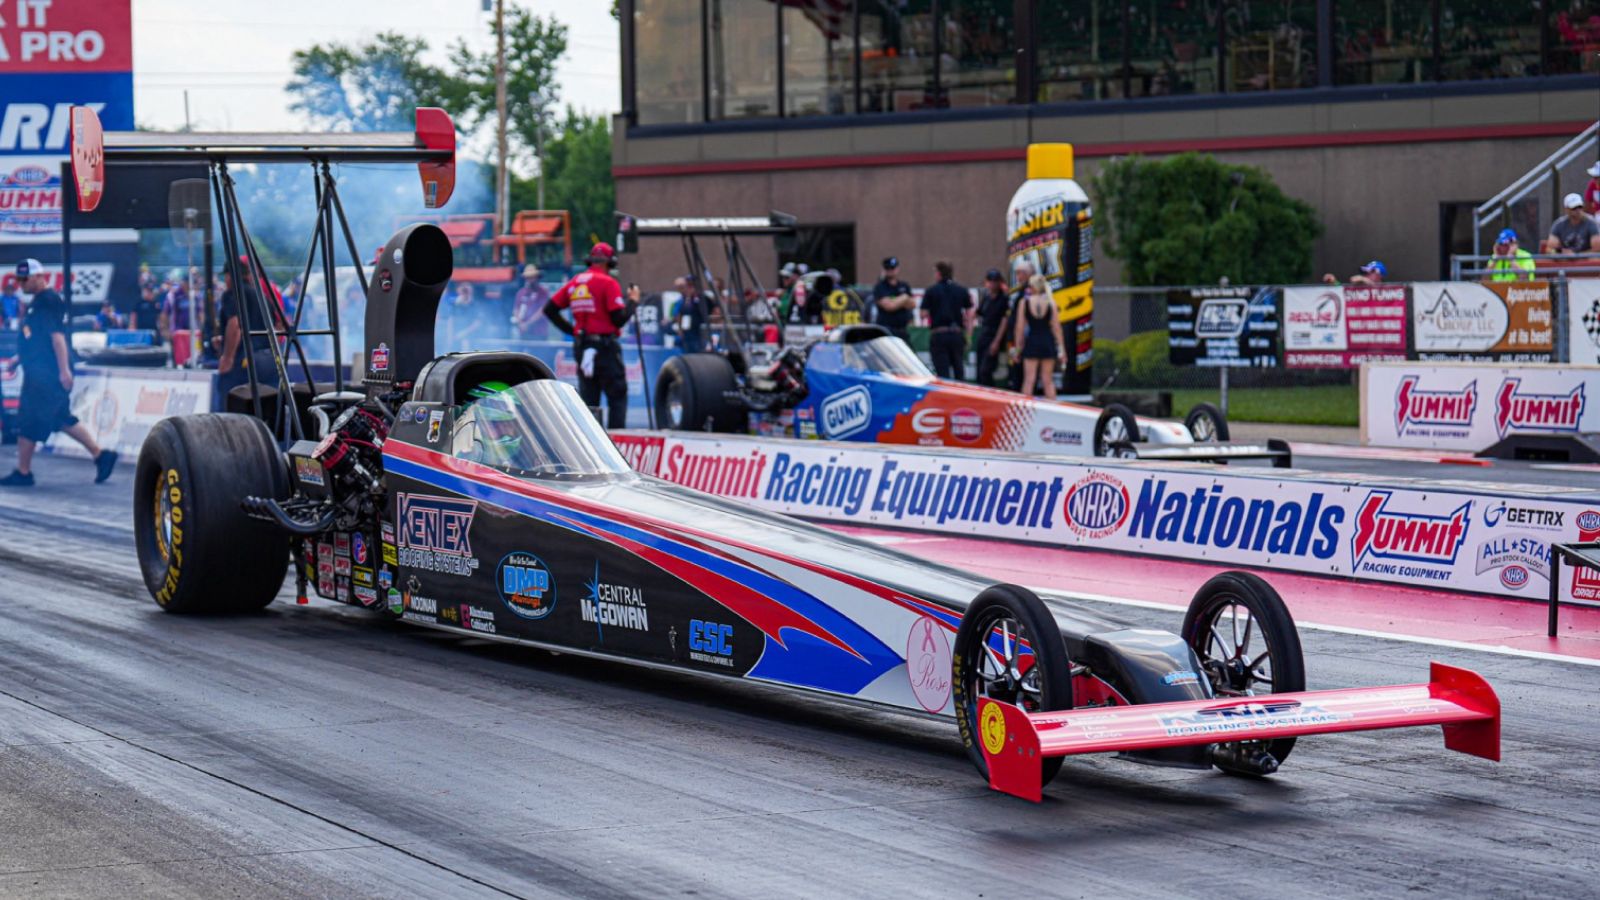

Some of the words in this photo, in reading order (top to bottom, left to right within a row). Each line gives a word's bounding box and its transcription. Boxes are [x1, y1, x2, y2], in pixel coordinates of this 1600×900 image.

[21, 30, 105, 61] PRO
[1371, 288, 1405, 301] TUNING
[1507, 287, 1550, 304] Apartment
[1529, 307, 1551, 326] living
[826, 399, 864, 428] GUNK
[667, 444, 768, 499] Summit
[765, 452, 873, 515] Racing
[870, 460, 1063, 525] Equipment
[1075, 471, 1123, 489] CHAMPIONSHIP
[1072, 479, 1121, 529] NHRA
[1128, 478, 1345, 560] Nationals
[1507, 507, 1566, 527] GETTRX
[155, 468, 183, 605] GOODYEAR
[1088, 524, 1119, 540] RACING
[398, 547, 435, 571] ROOFING
[435, 551, 473, 577] SYSTEMS
[1362, 562, 1397, 575] RACING
[1398, 566, 1453, 582] EQUIPMENT
[1490, 556, 1502, 565] PRO
[1502, 553, 1520, 562] STOCK
[1520, 556, 1544, 569] CALLOUT
[503, 565, 549, 598] DMP
[410, 596, 437, 614] NOONAN
[598, 583, 647, 607] CENTRAL
[580, 599, 649, 632] McGOWAN
[689, 619, 734, 656] ESC
[912, 653, 950, 692] Rose
[1166, 720, 1250, 736] ROOFING
[1254, 713, 1338, 729] SYSTEMS
